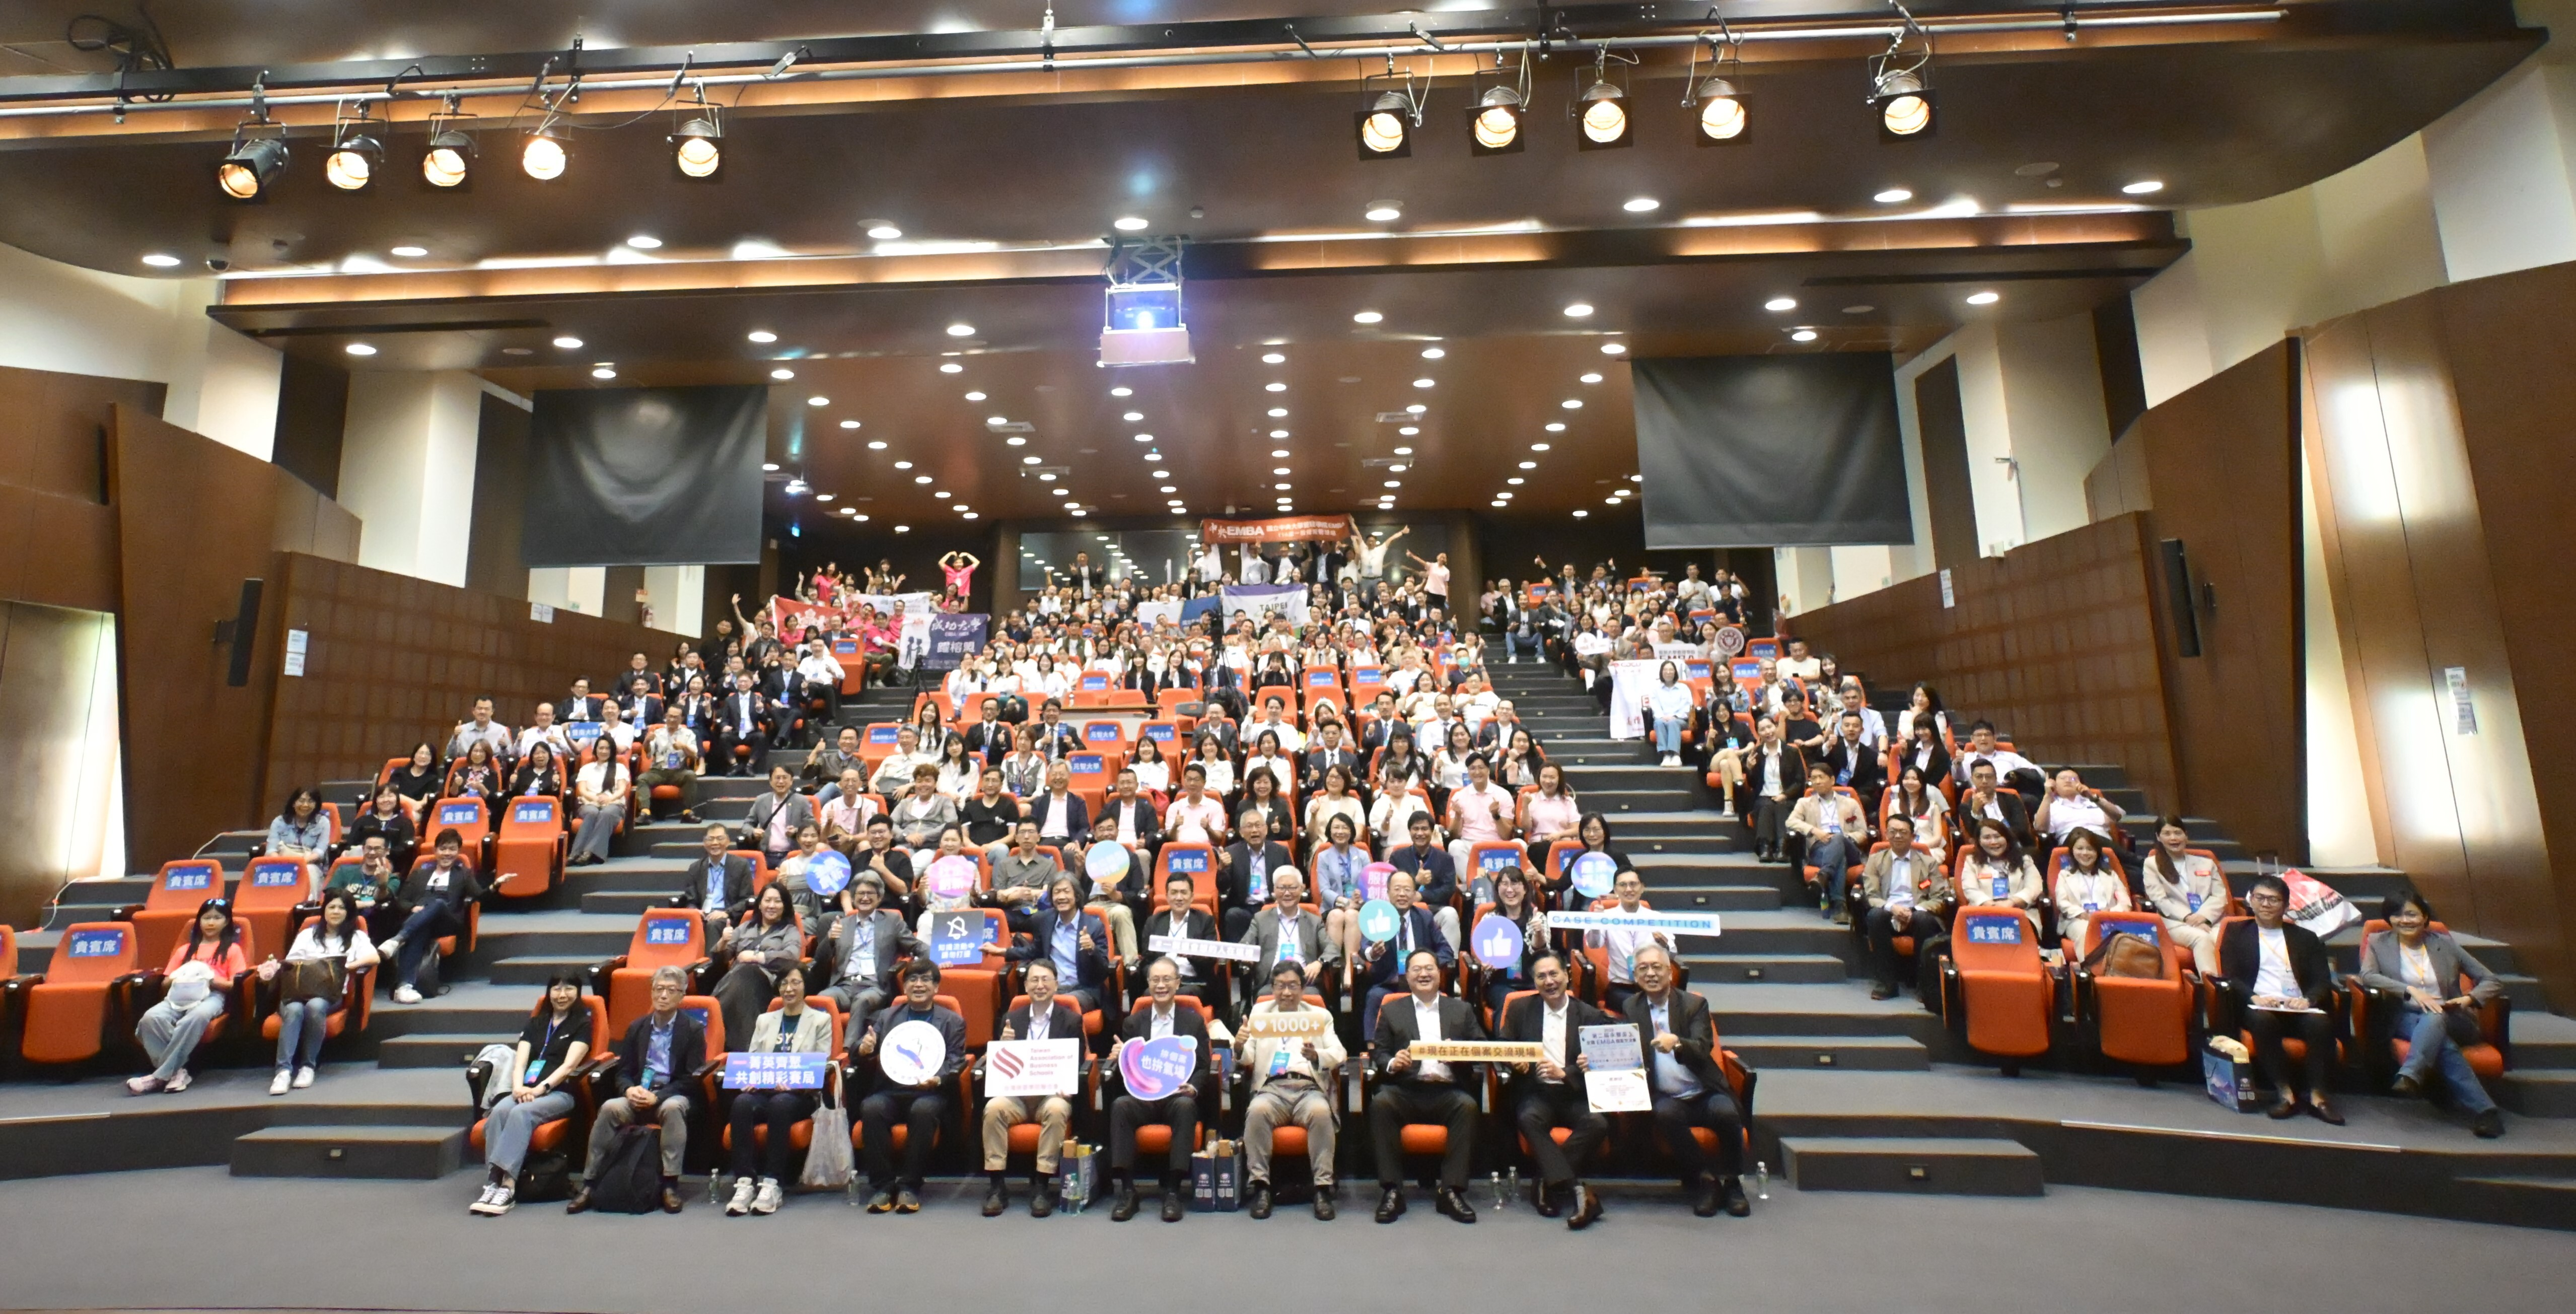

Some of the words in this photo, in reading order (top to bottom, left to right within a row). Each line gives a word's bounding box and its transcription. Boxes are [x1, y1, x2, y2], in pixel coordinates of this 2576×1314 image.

[1227, 526, 1265, 536] EMBA
[1260, 602, 1287, 612] TAIPEI
[445, 811, 474, 821] 貴賓席
[519, 810, 549, 820] 貴賓席
[1172, 858, 1204, 869] 貴賓席
[1484, 858, 1516, 869] 貴賓席
[171, 875, 207, 887] 貴賓席
[258, 872, 293, 883] 貴賓席
[1552, 916, 1592, 925] CASE
[1601, 918, 1711, 929] COMPETITION
[651, 928, 685, 941] 貴賓席
[1973, 926, 2015, 940] 貴賓席
[75, 940, 116, 953] 貴賓席
[1270, 1018, 1320, 1032] 1000+
[1419, 1045, 1536, 1057] #現在正在個案交流現場
[749, 1056, 802, 1070] 菁英齊聚
[735, 1070, 815, 1085] 共創精彩賽局
